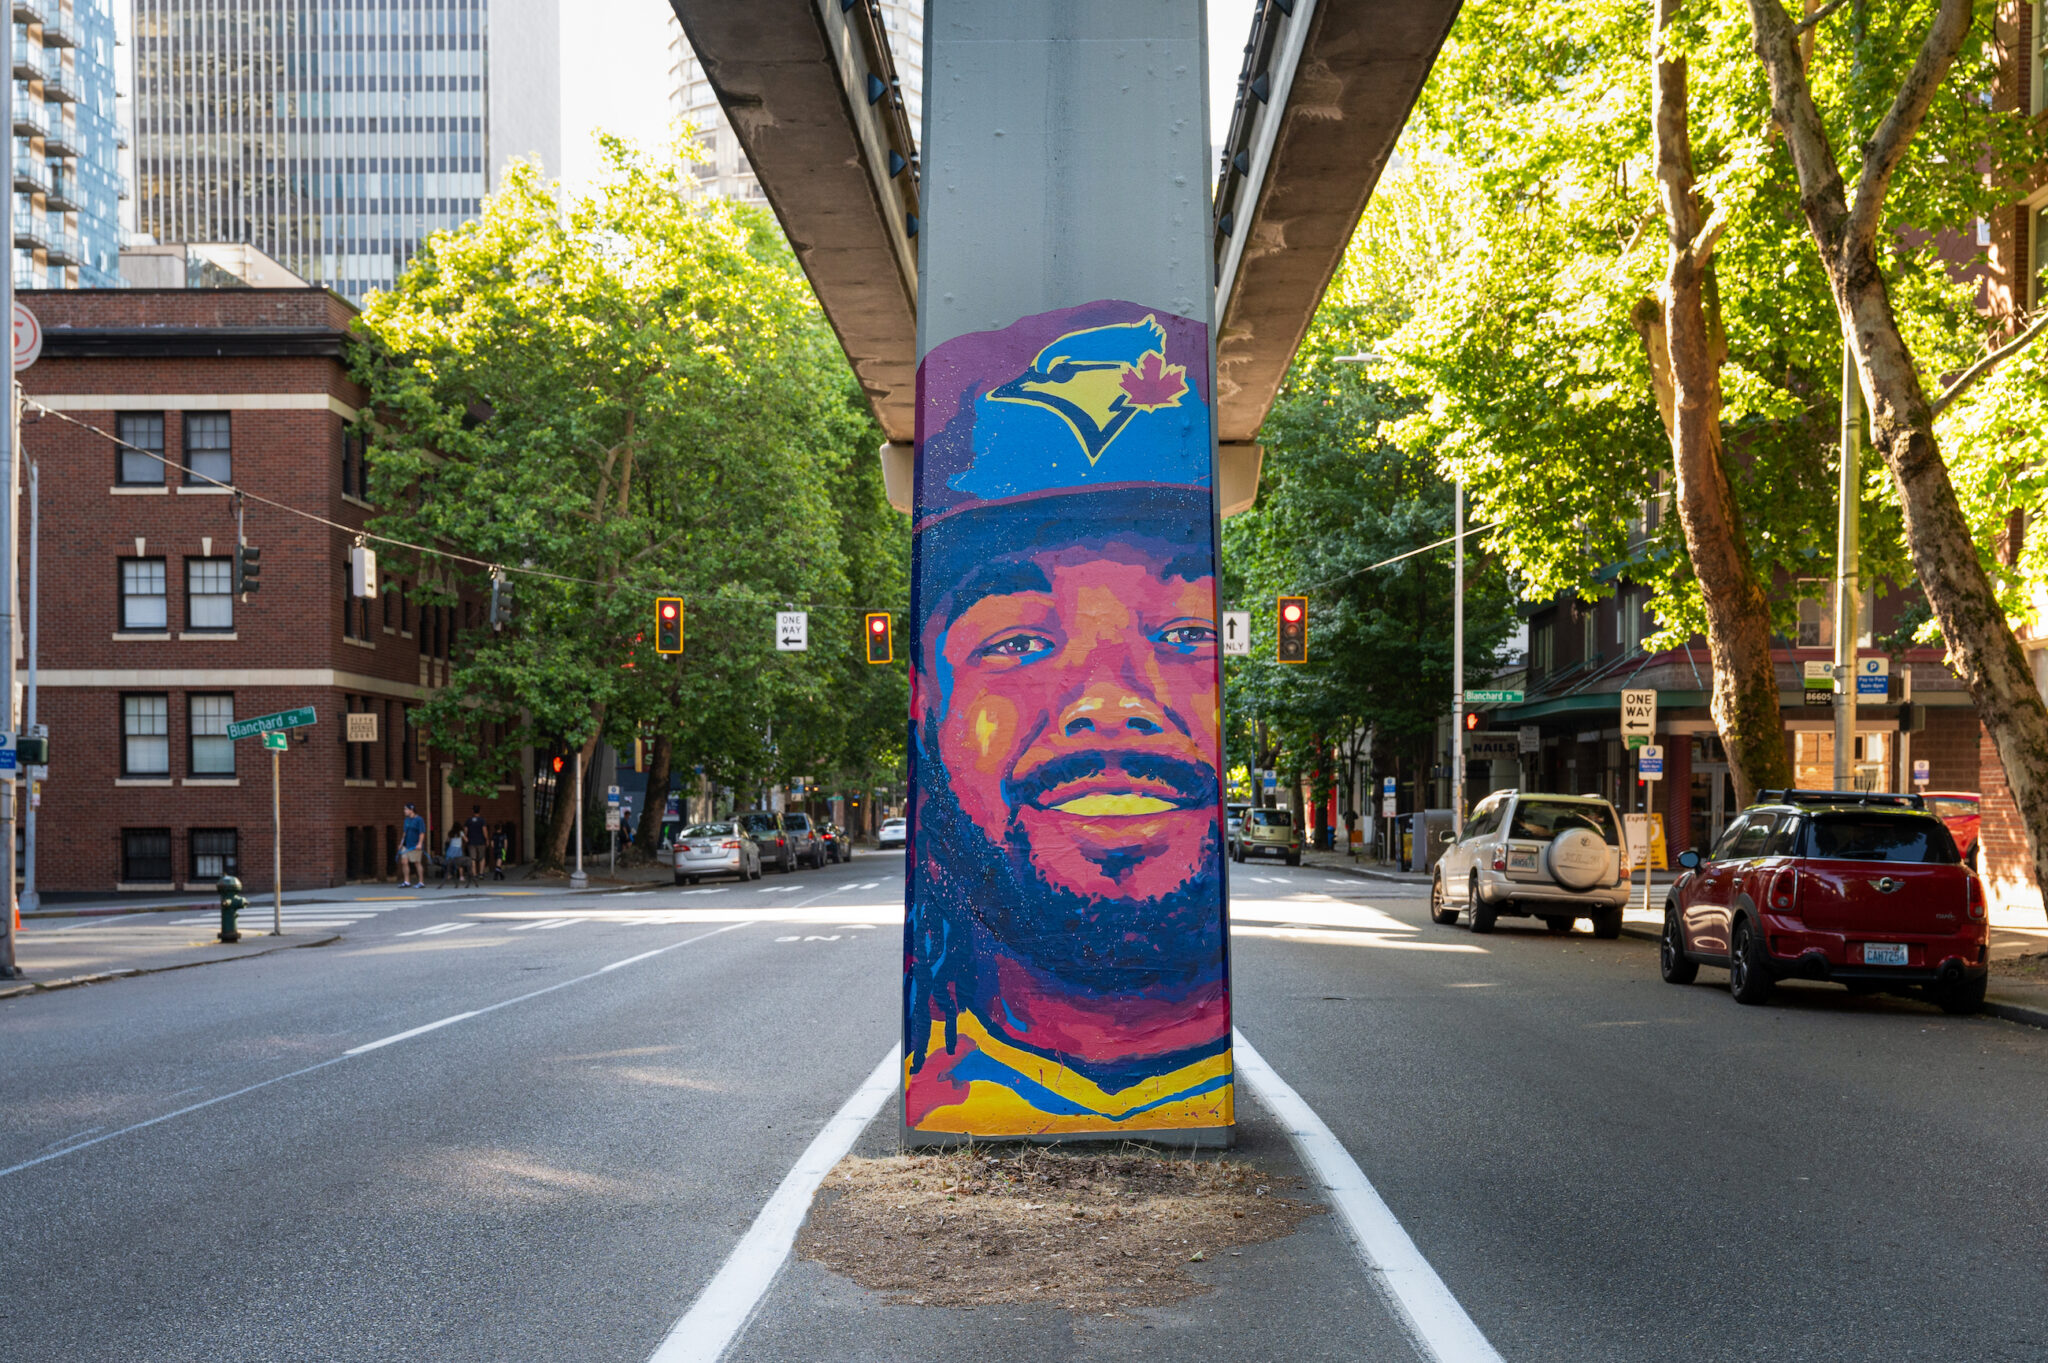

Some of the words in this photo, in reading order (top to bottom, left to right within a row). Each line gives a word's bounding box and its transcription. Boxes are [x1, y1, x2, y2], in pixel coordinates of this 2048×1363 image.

[782, 616, 801, 624] ONE
[782, 626, 801, 634] WAY
[1224, 642, 1244, 651] NLY
[1466, 691, 1503, 700] Blanchard
[1626, 694, 1652, 704] ONE
[1625, 707, 1652, 717] WAY
[229, 715, 283, 738] Blanchard
[288, 715, 298, 724] St
[1473, 743, 1516, 752] NAILS
